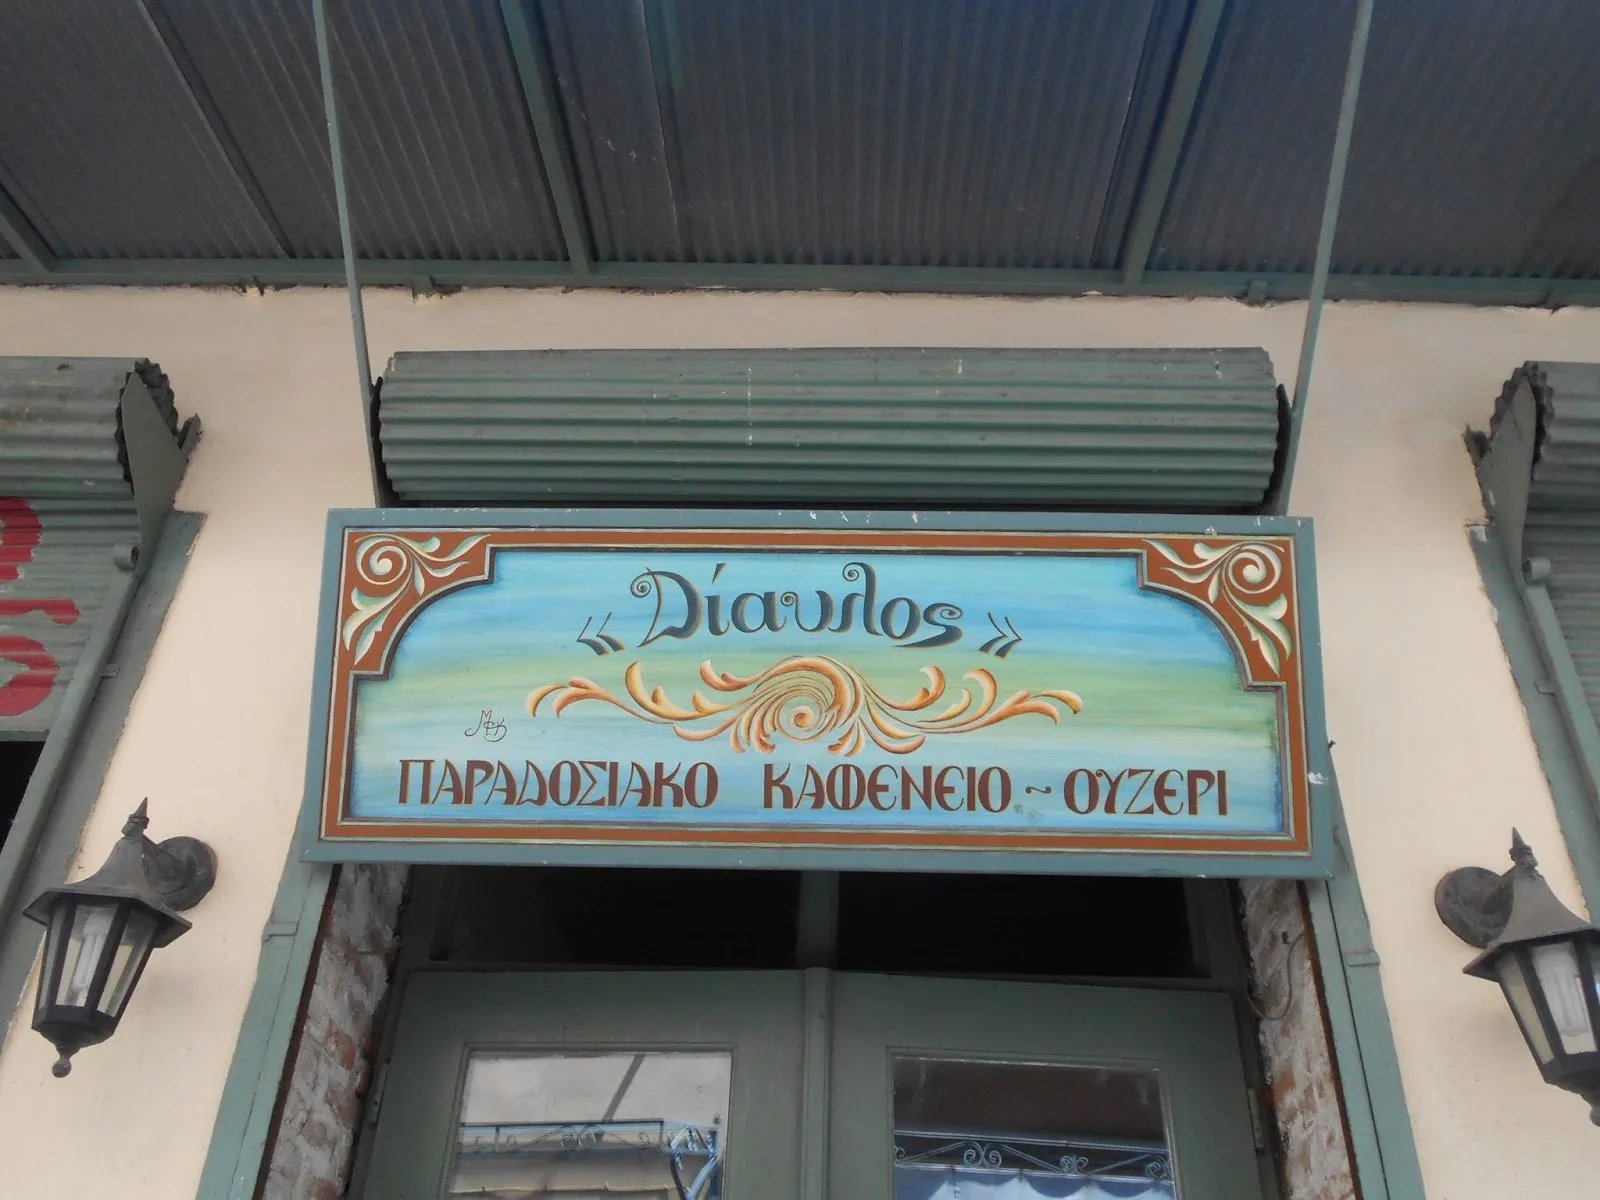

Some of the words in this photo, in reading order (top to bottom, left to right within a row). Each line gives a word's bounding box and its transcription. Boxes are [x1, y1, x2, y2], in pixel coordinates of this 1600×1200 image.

[398, 759, 718, 808] ΠΑΡΑΔΟΣΙΑΚΟ
[763, 763, 1012, 813] ΚΑΦΕΝΕΙΟ
[1063, 768, 1229, 816] ΟΥΖΕΡΙ
